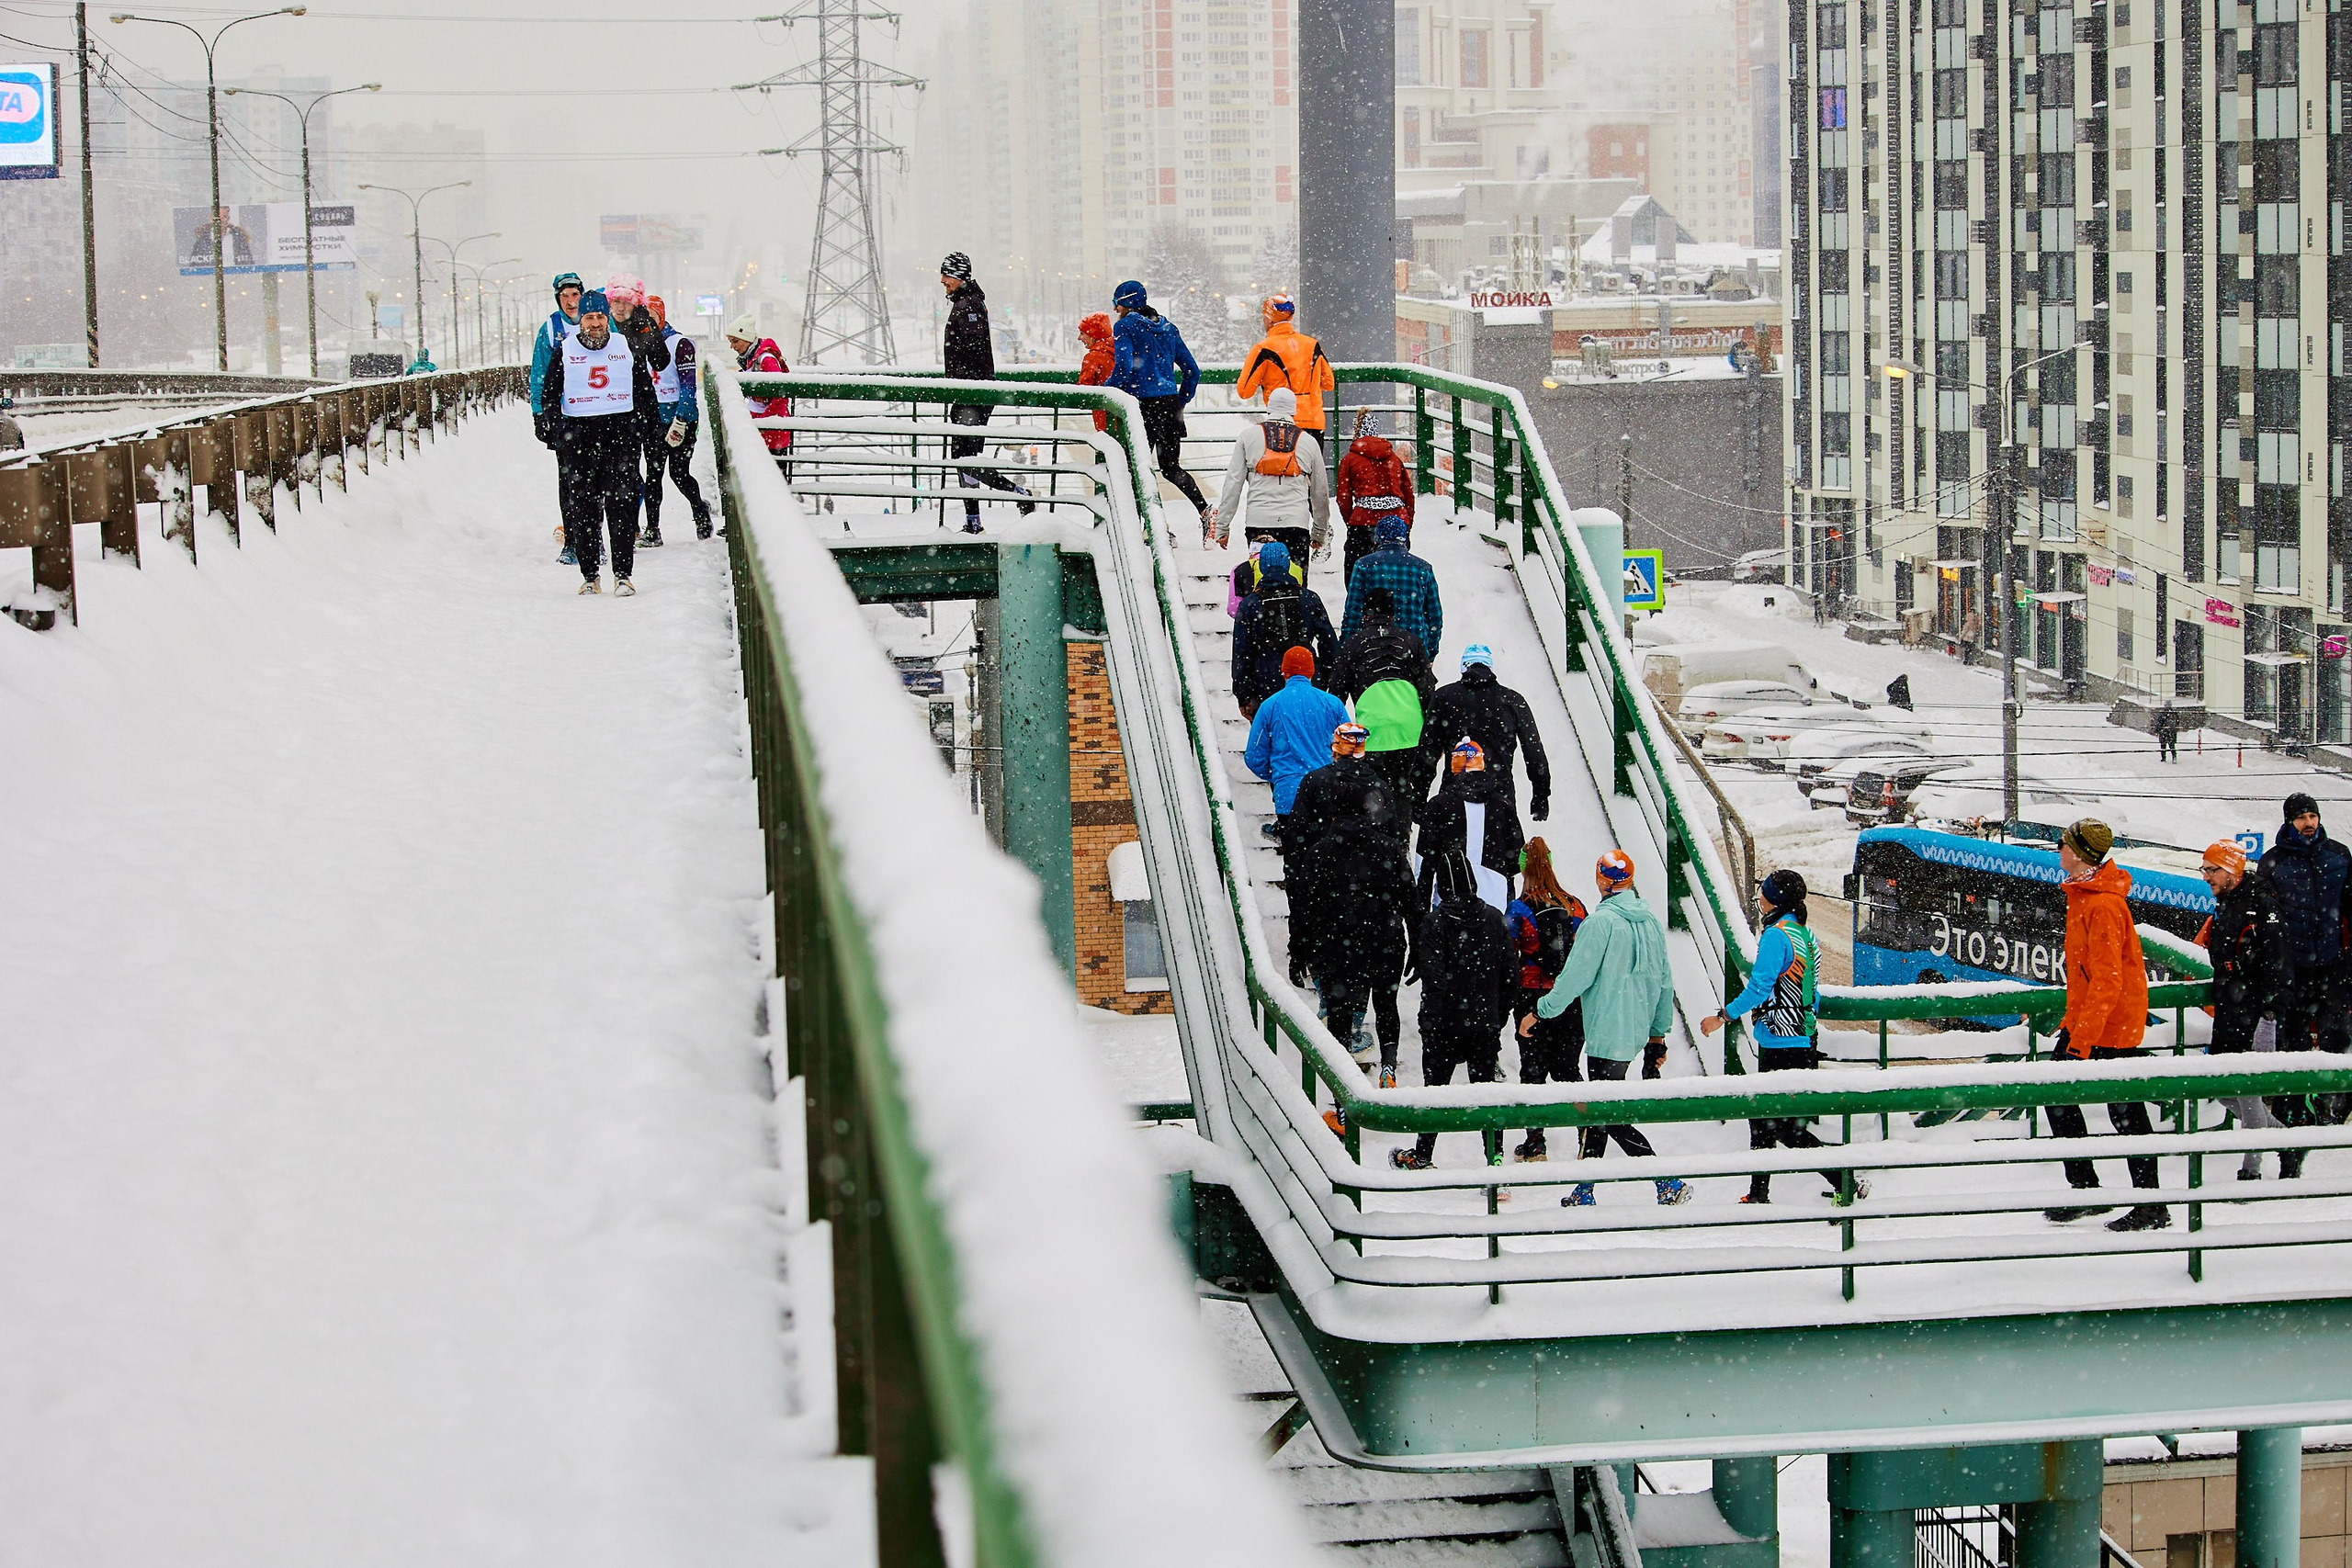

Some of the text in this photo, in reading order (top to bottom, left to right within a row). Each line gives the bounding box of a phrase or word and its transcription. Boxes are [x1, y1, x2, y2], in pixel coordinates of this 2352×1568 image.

[277, 235, 345, 244] БЕСПАТНЫЕ
[278, 243, 342, 252] ХИМЧСТКИ
[1471, 290, 1553, 307] МОЙКА
[588, 366, 610, 389] 5
[2242, 836, 2258, 853] P
[1930, 911, 1986, 965] Это
